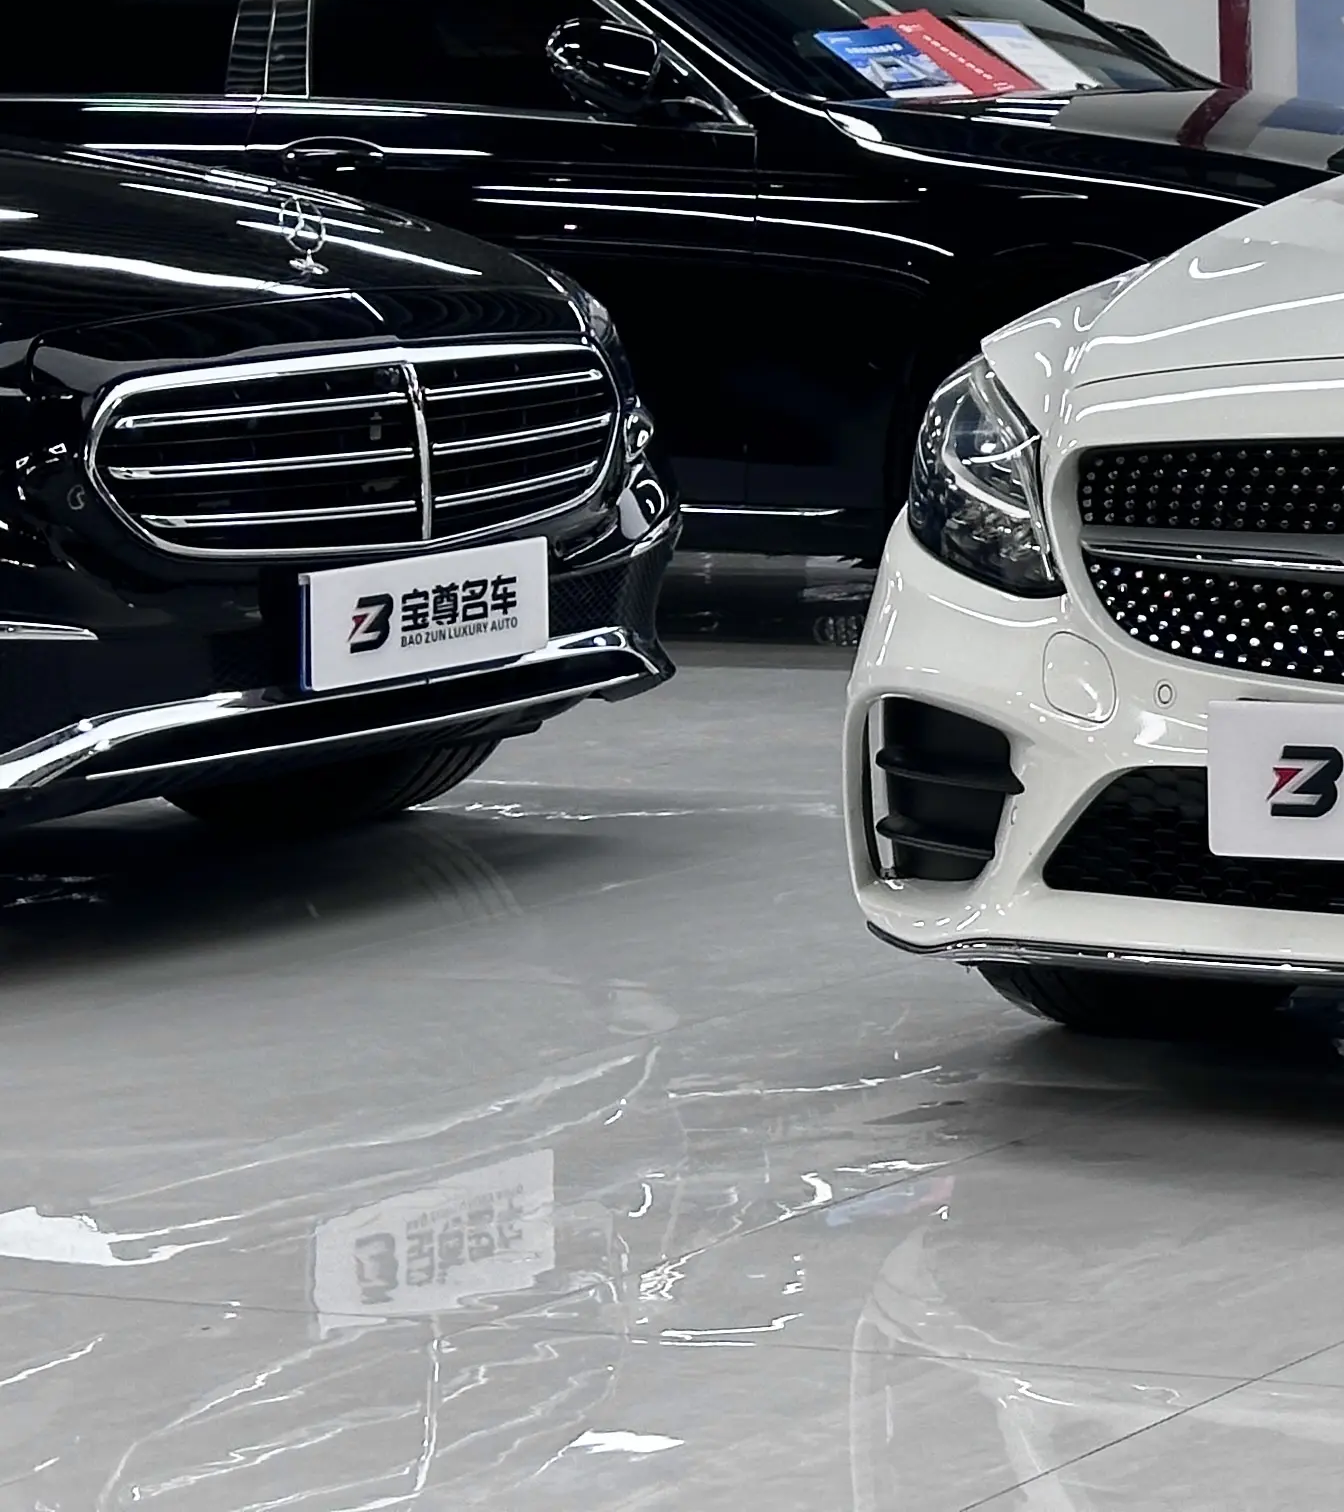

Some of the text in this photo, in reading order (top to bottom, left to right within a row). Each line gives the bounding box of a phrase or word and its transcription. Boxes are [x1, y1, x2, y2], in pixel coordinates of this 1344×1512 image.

[401, 574, 517, 632] 宝尊名车
[401, 616, 518, 648] BAO ZUN LUXURY AUTO
